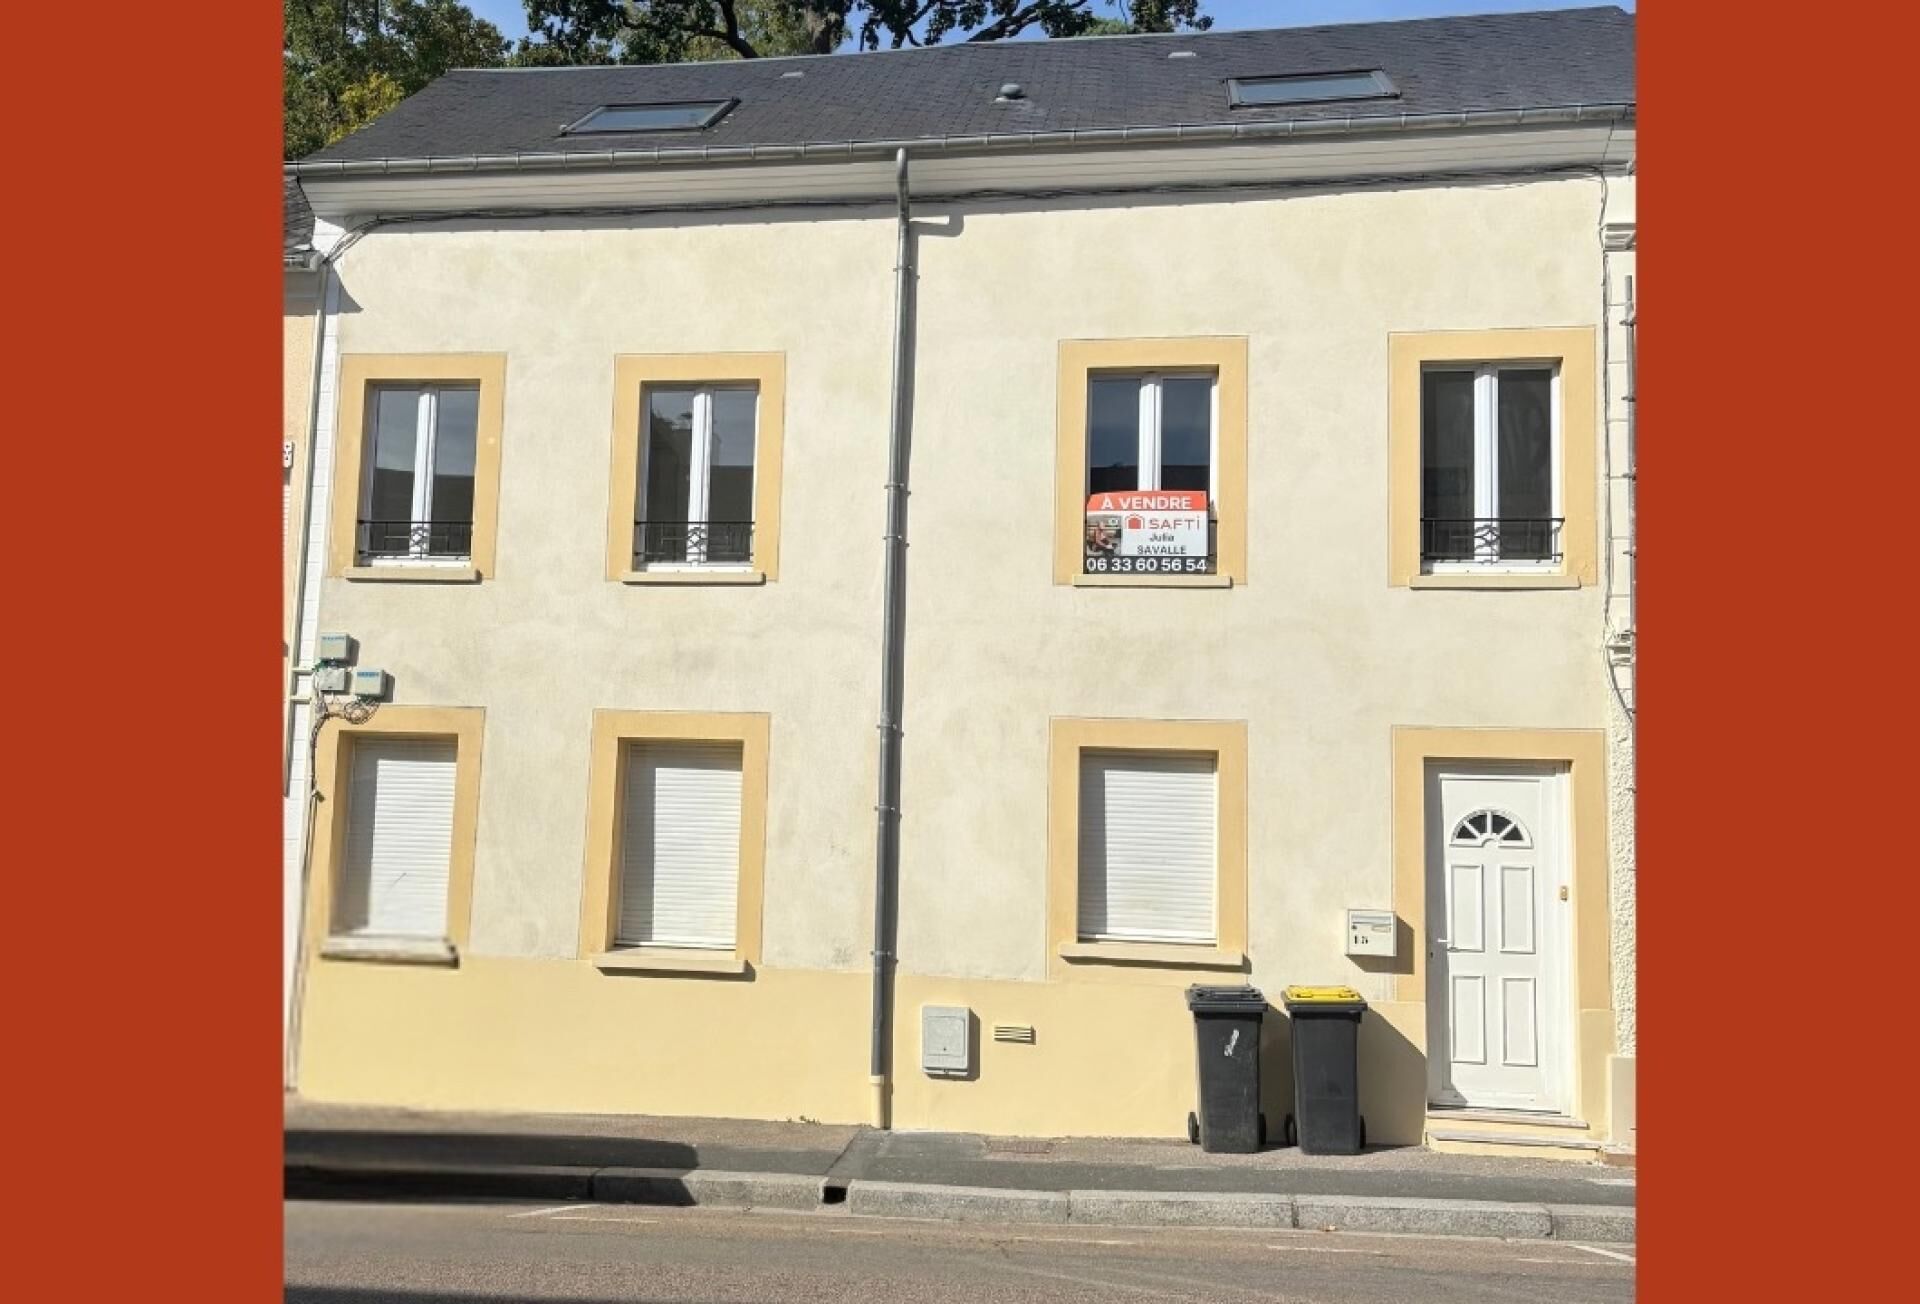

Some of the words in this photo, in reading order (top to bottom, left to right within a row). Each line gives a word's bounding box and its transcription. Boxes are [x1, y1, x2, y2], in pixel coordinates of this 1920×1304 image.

[1119, 496, 1192, 510] VENDRE
[1149, 532, 1175, 542] Julia
[1137, 545, 1187, 555] SAVALLE
[1086, 558, 1107, 572] 06
[1111, 558, 1132, 572] 33
[1135, 558, 1158, 572] 60
[1161, 558, 1182, 572] 56
[1185, 558, 1207, 572] 54
